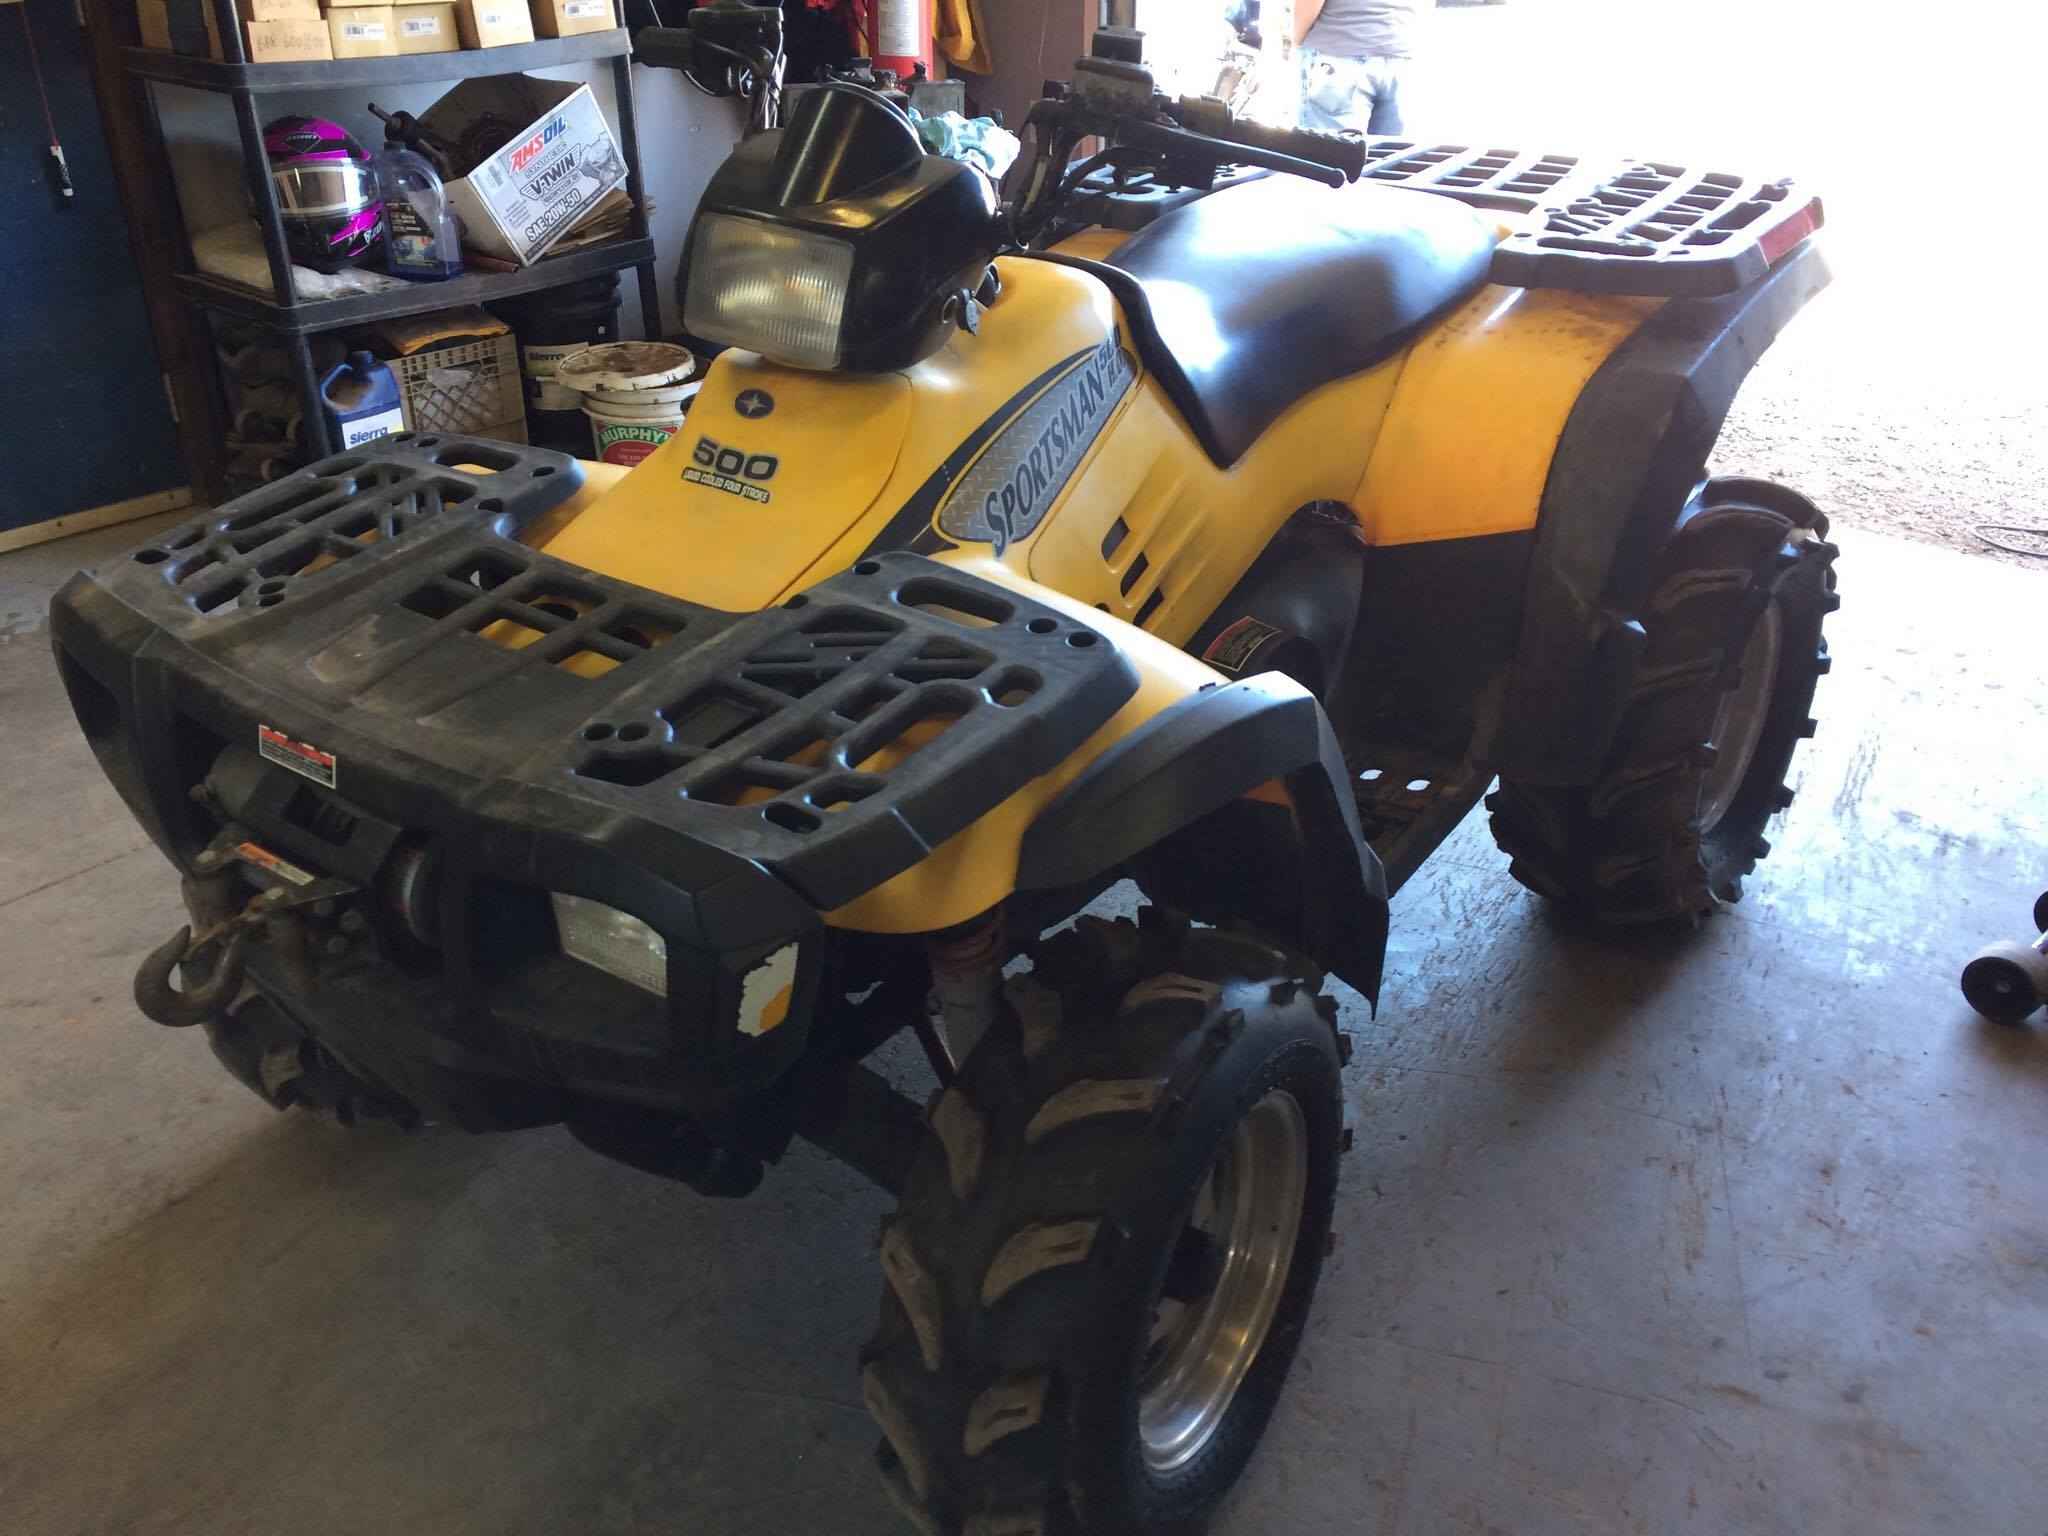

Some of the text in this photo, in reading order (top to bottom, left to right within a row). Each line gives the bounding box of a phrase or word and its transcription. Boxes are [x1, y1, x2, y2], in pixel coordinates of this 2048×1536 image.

[509, 115, 568, 175] AMSOIL
[530, 153, 576, 195] V-TWIN
[525, 216, 547, 242] SAE
[544, 188, 582, 224] 20W-50
[350, 427, 388, 444] sierra
[693, 437, 778, 480] 500
[986, 360, 1105, 557] SPORTSMAN
